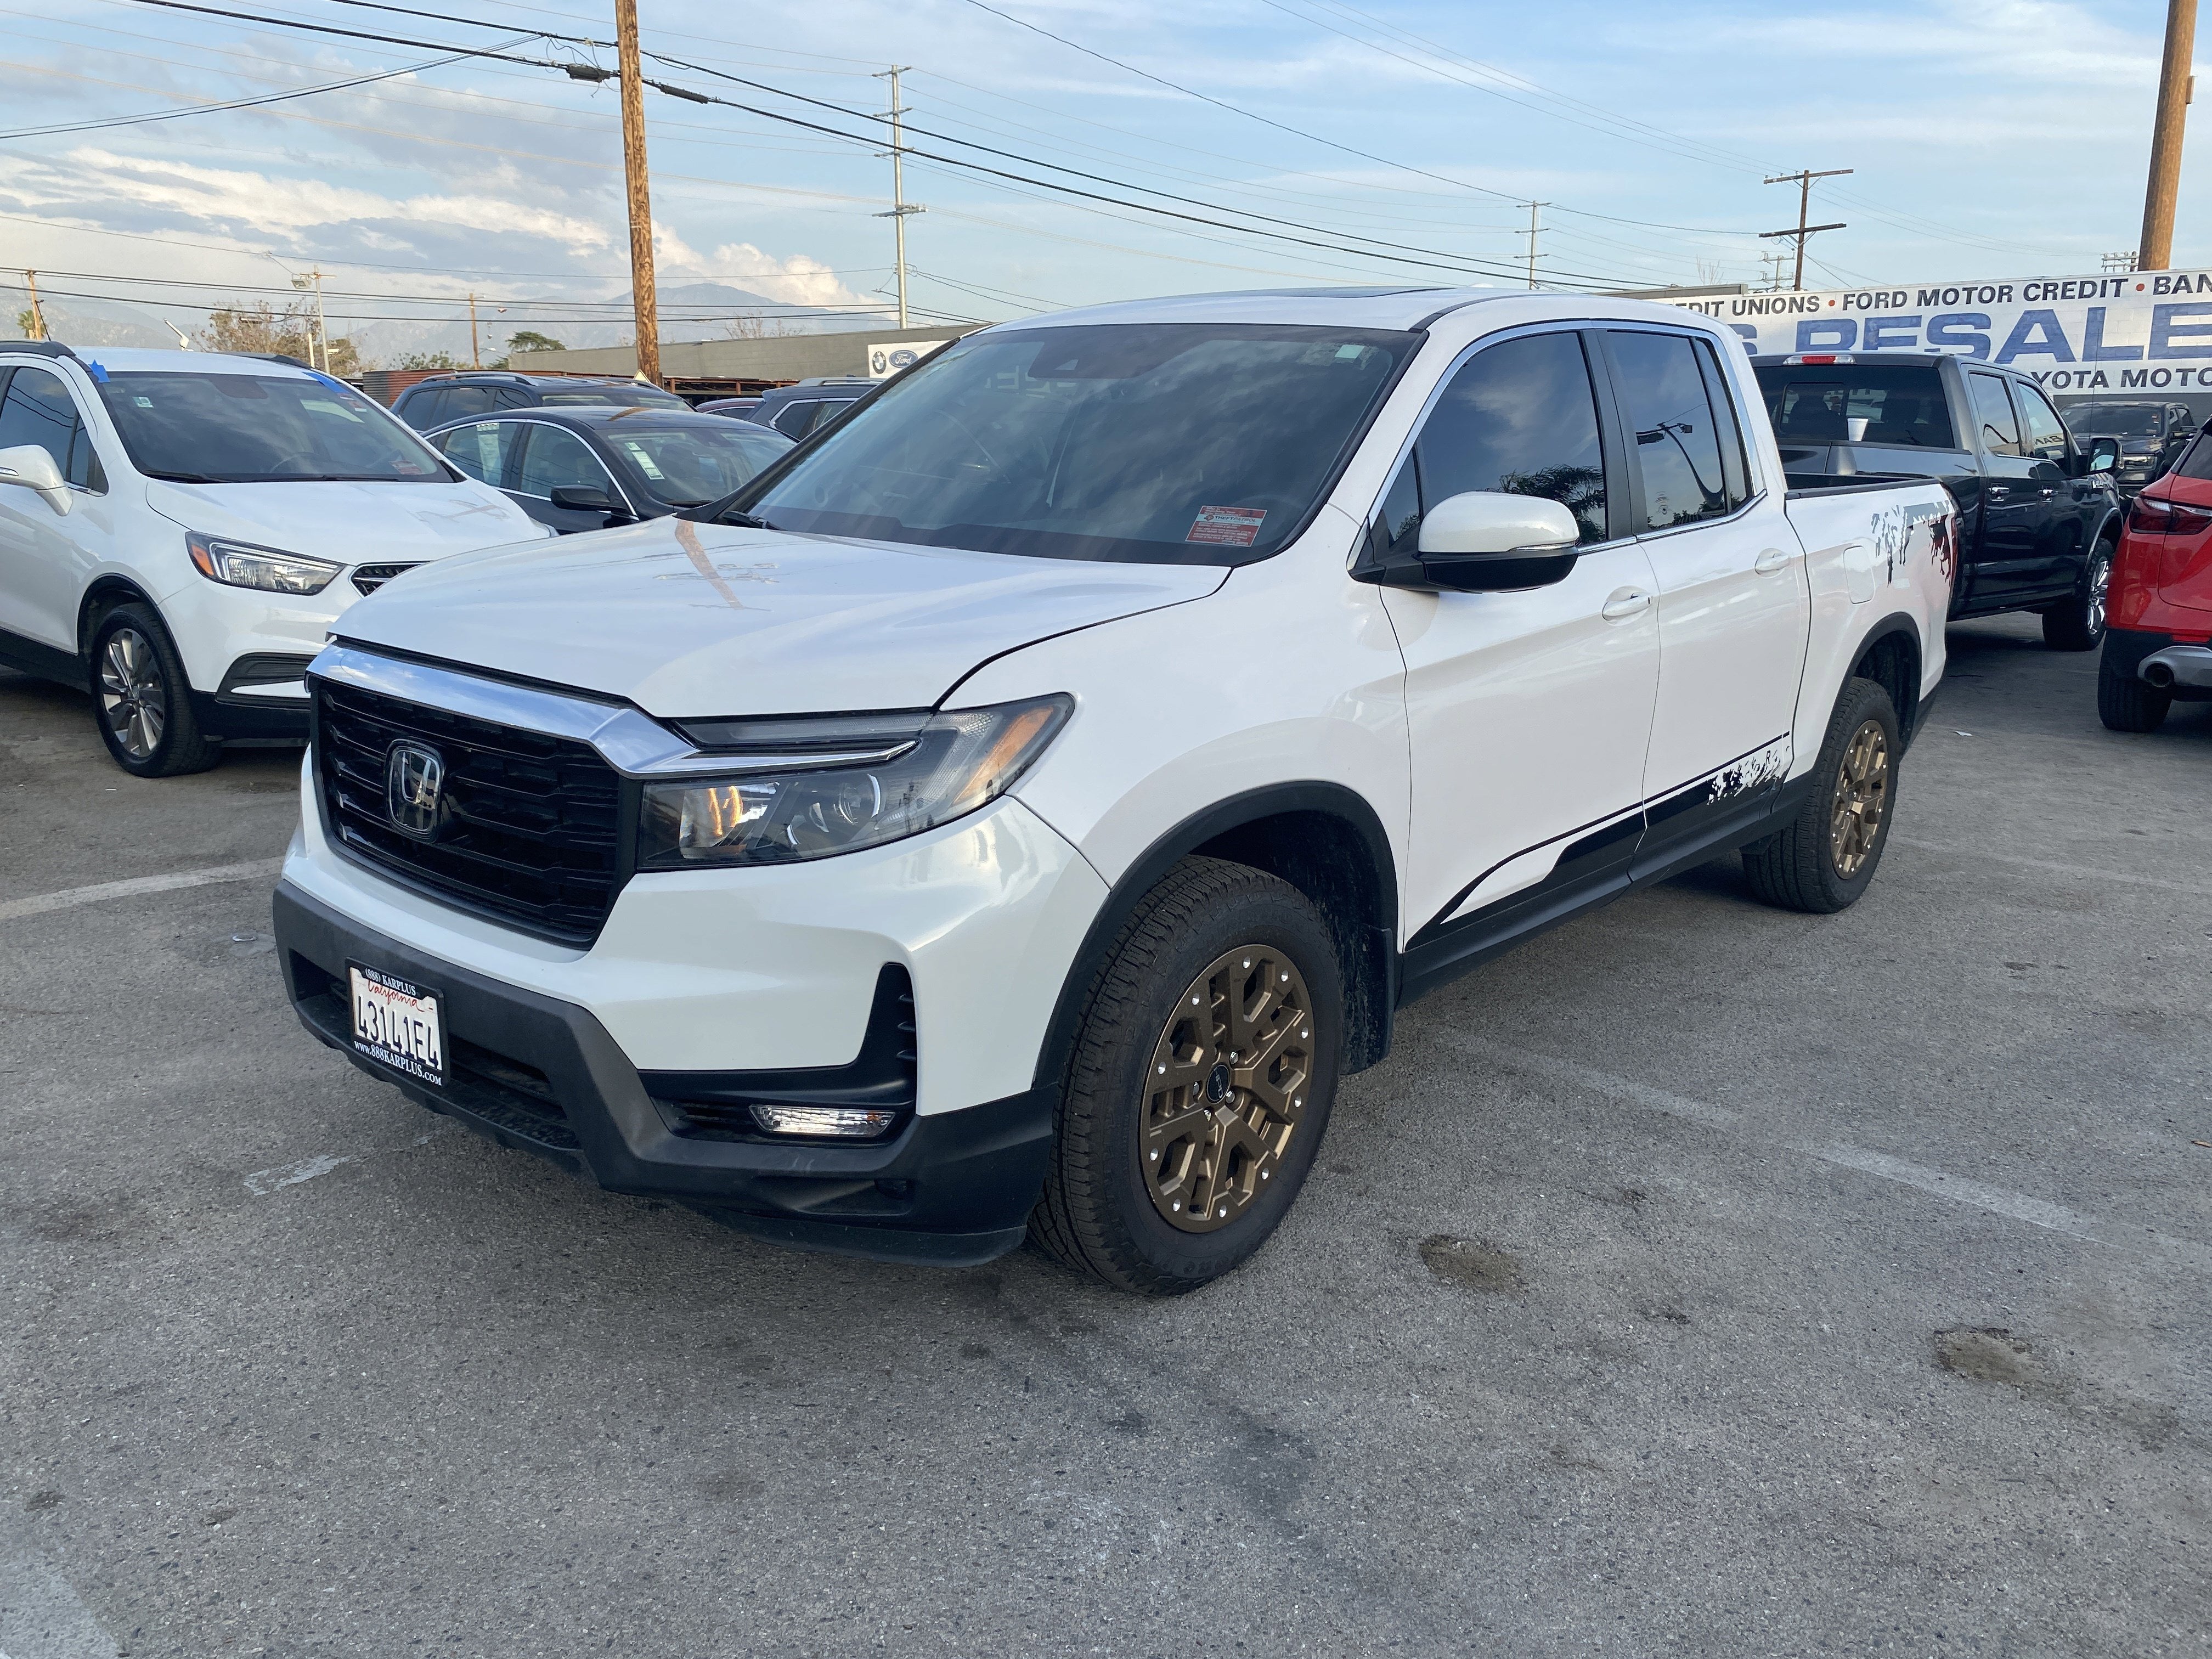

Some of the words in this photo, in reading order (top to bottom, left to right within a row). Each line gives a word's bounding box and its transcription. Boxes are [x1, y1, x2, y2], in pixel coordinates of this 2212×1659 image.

[1732, 296, 1820, 316] UNIONS
[1842, 291, 1908, 311] FORD
[1917, 285, 2013, 307] MOTOR
[2023, 278, 2129, 302] CREDIT
[895, 353, 912, 364] Ford
[365, 968, 381, 982] (888)
[382, 974, 416, 996] KARPLUS
[368, 980, 425, 1012] California
[358, 995, 439, 1066] 43141E4
